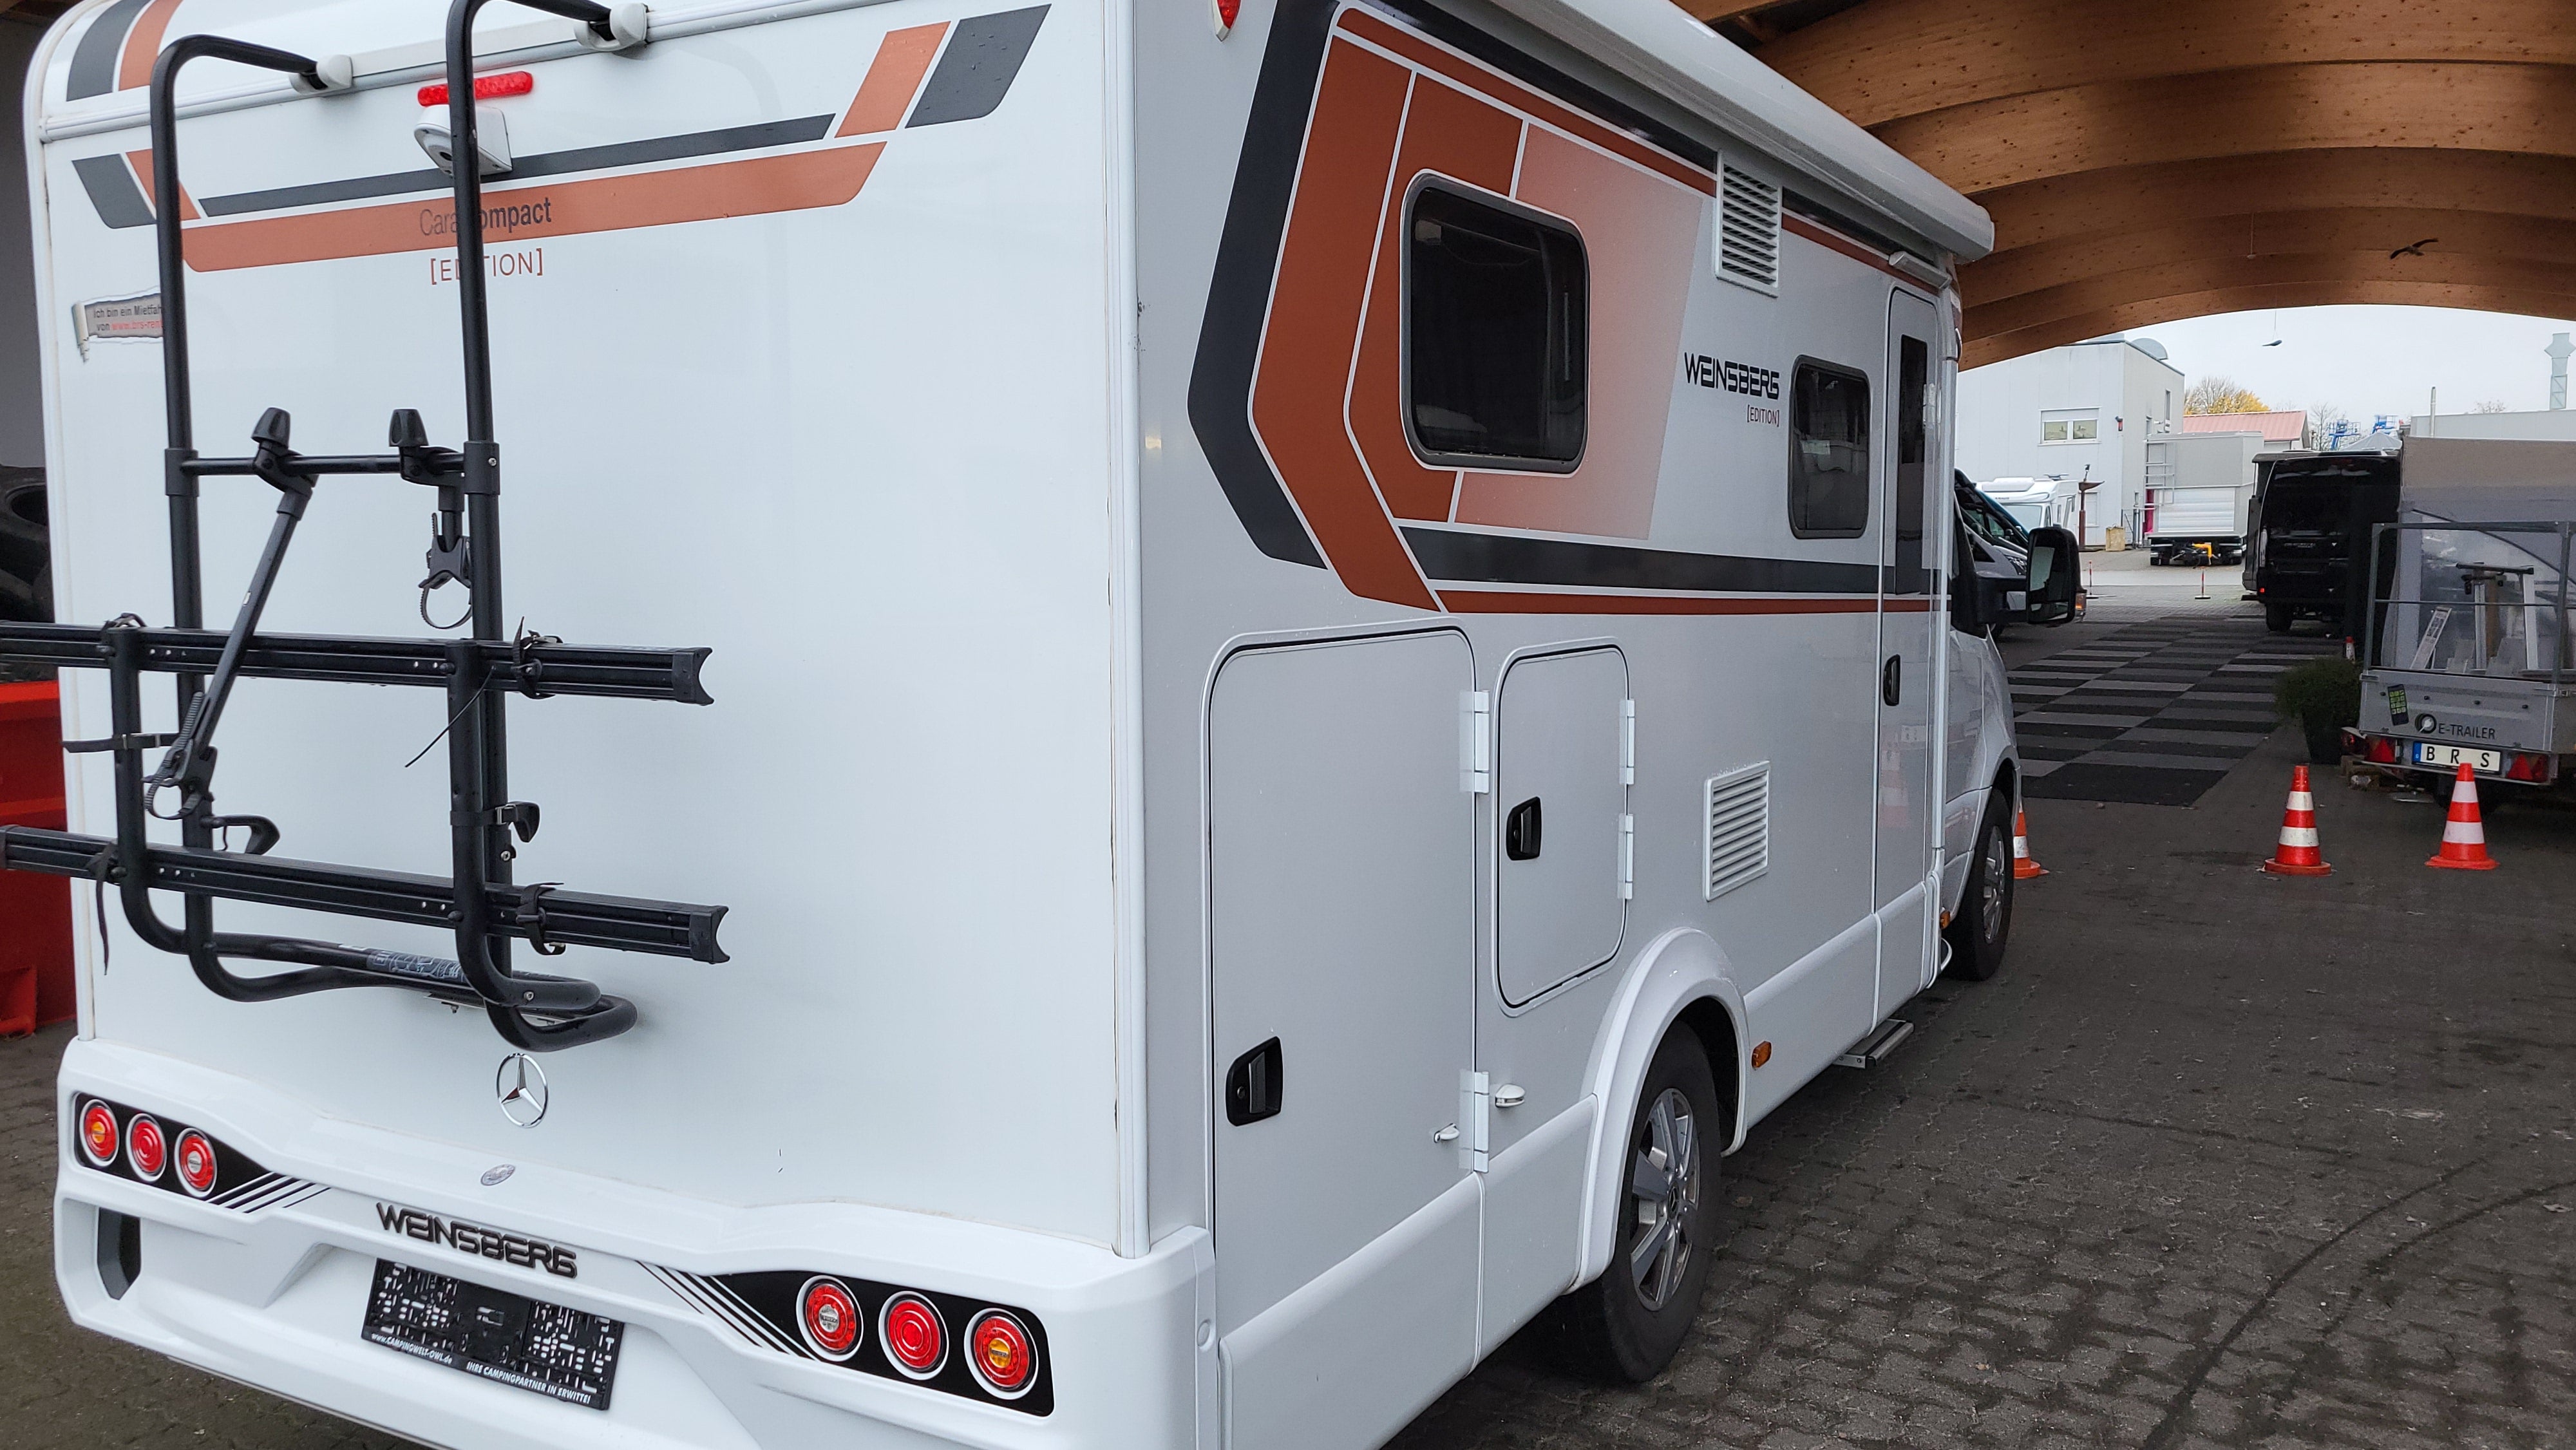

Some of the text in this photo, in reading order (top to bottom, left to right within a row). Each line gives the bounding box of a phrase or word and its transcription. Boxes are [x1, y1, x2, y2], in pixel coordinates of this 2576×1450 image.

[419, 197, 552, 236] Caraompact
[430, 248, 543, 285] [EION]
[94, 303, 162, 318] Ich bin ein Mietfah
[97, 323, 110, 332] von
[1684, 352, 1779, 400] WEINSBERG
[1747, 404, 1779, 427] [EDITION]
[2438, 723, 2496, 739] E-TRAILER
[376, 1201, 578, 1279] WEINSBERG
[466, 1361, 483, 1373] IHRE
[484, 1365, 546, 1392] CAMPINGPARTNER
[547, 1384, 556, 1395] IN
